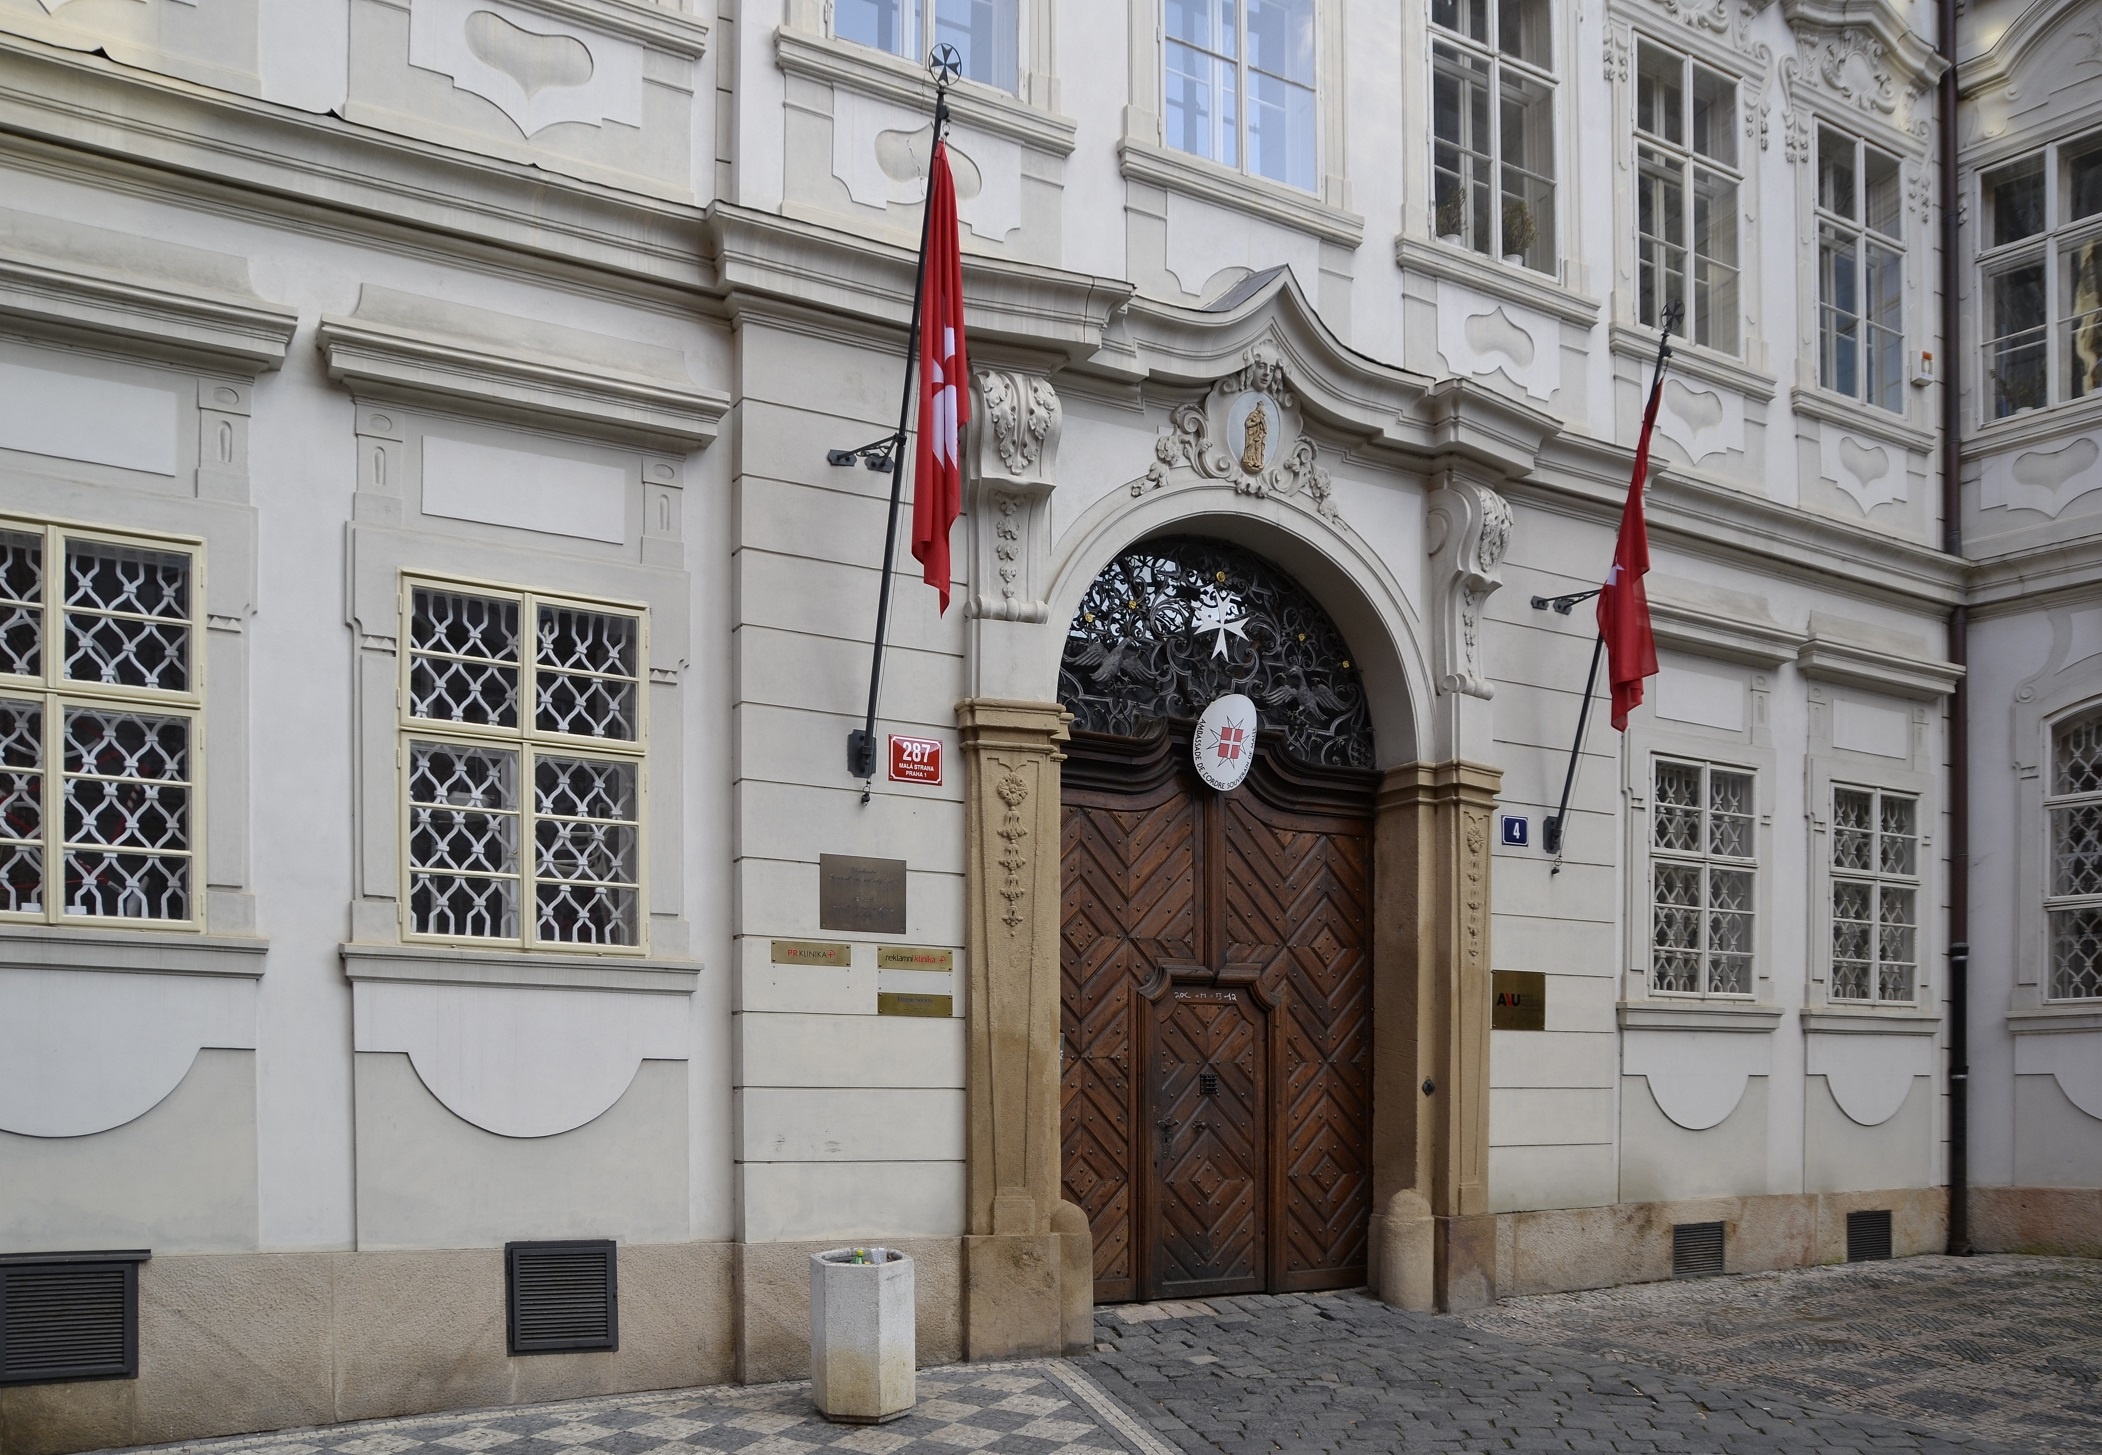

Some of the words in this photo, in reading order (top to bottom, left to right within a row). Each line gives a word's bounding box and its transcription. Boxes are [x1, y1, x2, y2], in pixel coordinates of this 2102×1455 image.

[1194, 718, 1207, 760] AMBASSADE
[902, 741, 931, 763] 287
[1248, 752, 1253, 760] DE
[898, 762, 914, 770] MALÁ
[913, 764, 935, 772] STRANA
[1196, 762, 1206, 773] DE
[905, 770, 923, 778] PRAHA
[1227, 761, 1250, 790] SOUVERAIN
[1513, 822, 1521, 839] 4
[914, 955, 936, 964] klinika
